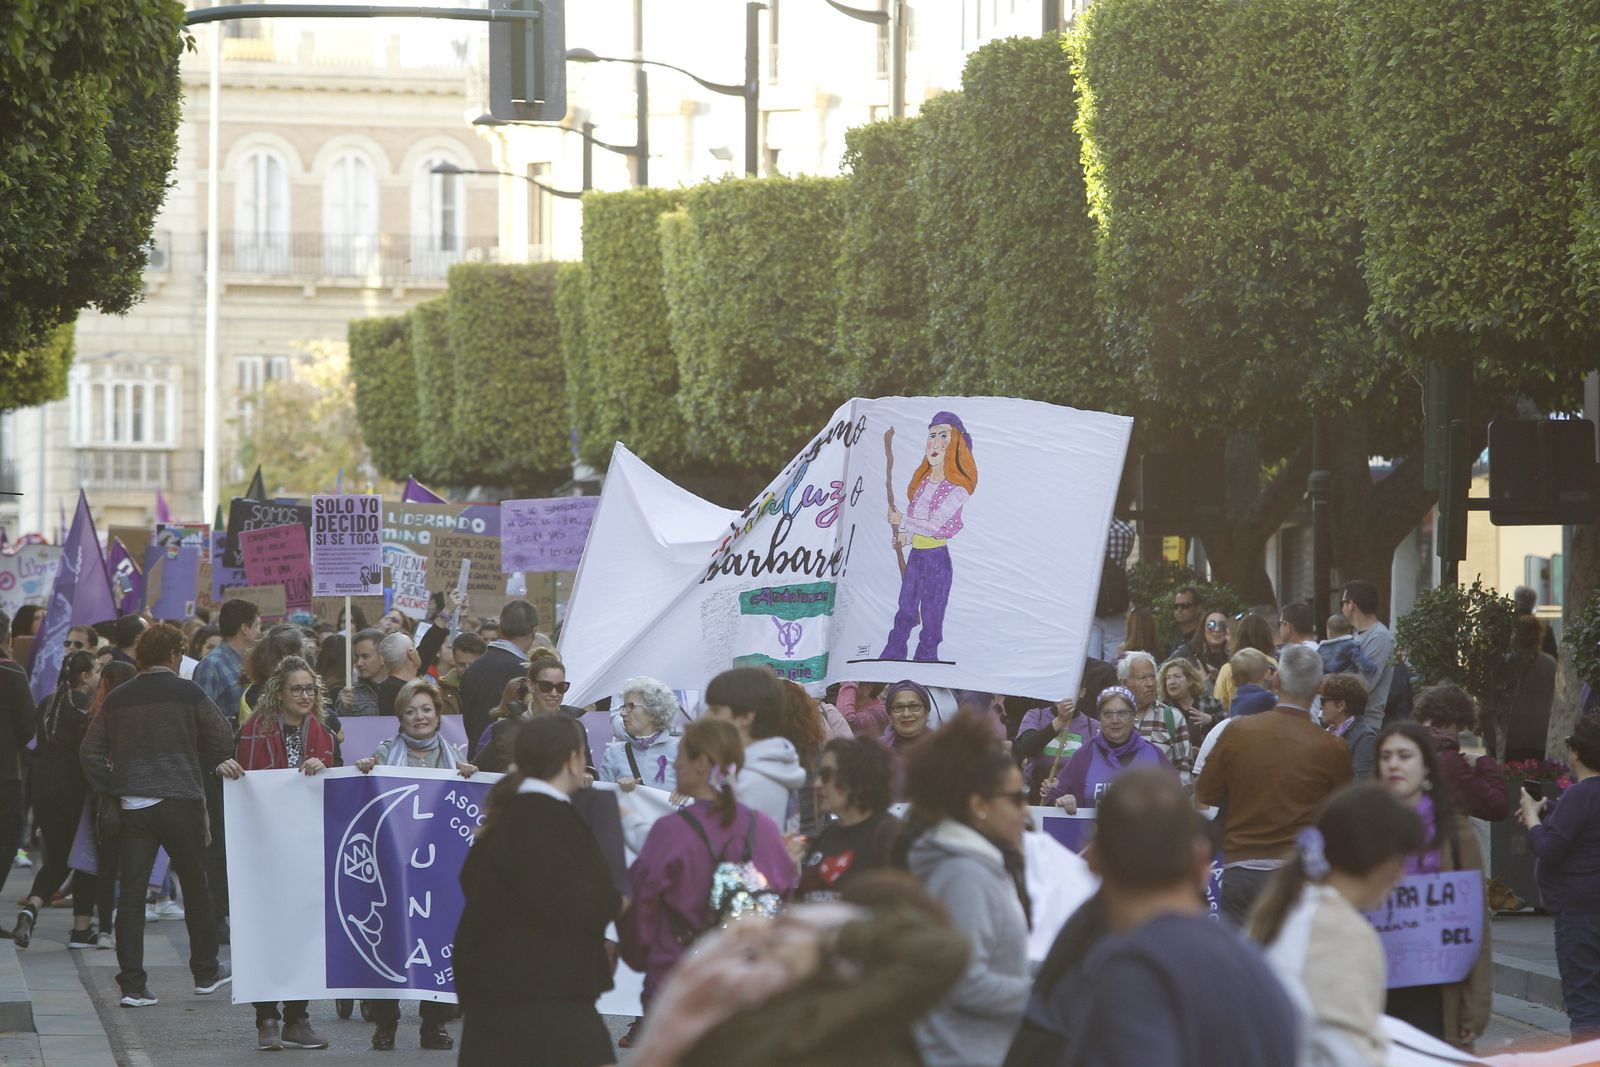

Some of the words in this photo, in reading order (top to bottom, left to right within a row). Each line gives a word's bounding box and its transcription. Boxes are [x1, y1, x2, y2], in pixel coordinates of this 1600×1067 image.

[251, 504, 299, 524] SOMOS
[315, 498, 355, 514] SOLO
[359, 498, 379, 514] YO
[315, 514, 379, 533] DECIDO
[315, 533, 327, 545] SI
[330, 533, 345, 545] SE
[349, 532, 379, 545] TOCA
[444, 790, 488, 827] ASOC
[1426, 882, 1456, 907] LA
[1441, 927, 1475, 946] DEL
